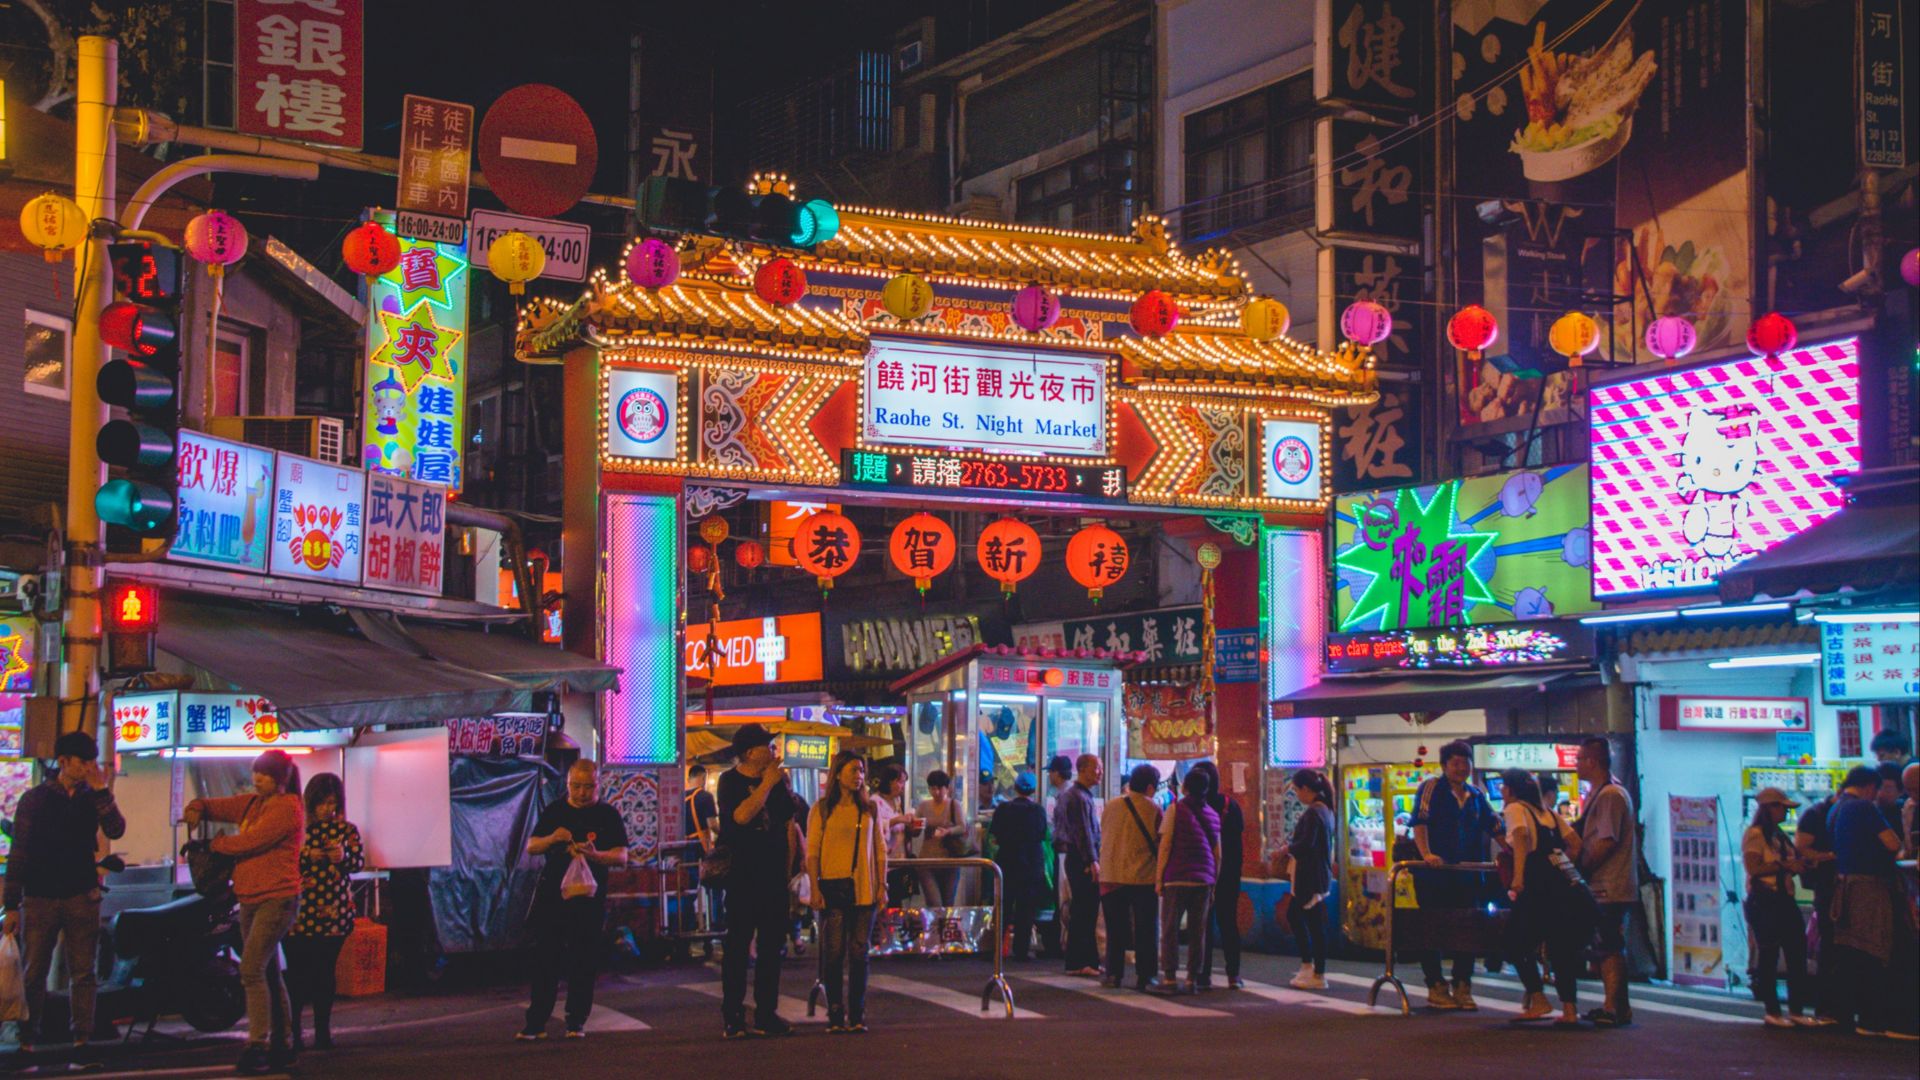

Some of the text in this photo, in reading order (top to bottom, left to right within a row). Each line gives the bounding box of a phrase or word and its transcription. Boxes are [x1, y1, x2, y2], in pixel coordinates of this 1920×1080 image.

[255, 0, 346, 136] 銀樓
[1870, 12, 1894, 87] 河街
[1866, 110, 1879, 122] St.
[410, 103, 434, 205] 禁止停車
[439, 107, 464, 210] 徒步區內
[651, 128, 698, 181] 永
[400, 215, 461, 243] 16:00-24:00
[876, 359, 1097, 405] 饒河街觀光夜市
[415, 383, 455, 483] 娃娃屋
[875, 406, 1098, 438] Raohe St. Night Market
[368, 479, 442, 536] 武大郎
[367, 530, 442, 588] 胡椒餅
[808, 524, 850, 569] 恭
[904, 526, 942, 570] 賀
[985, 535, 1027, 574] 新
[1346, 638, 1370, 657] claw
[1372, 641, 1405, 659] games
[1436, 633, 1456, 652] the
